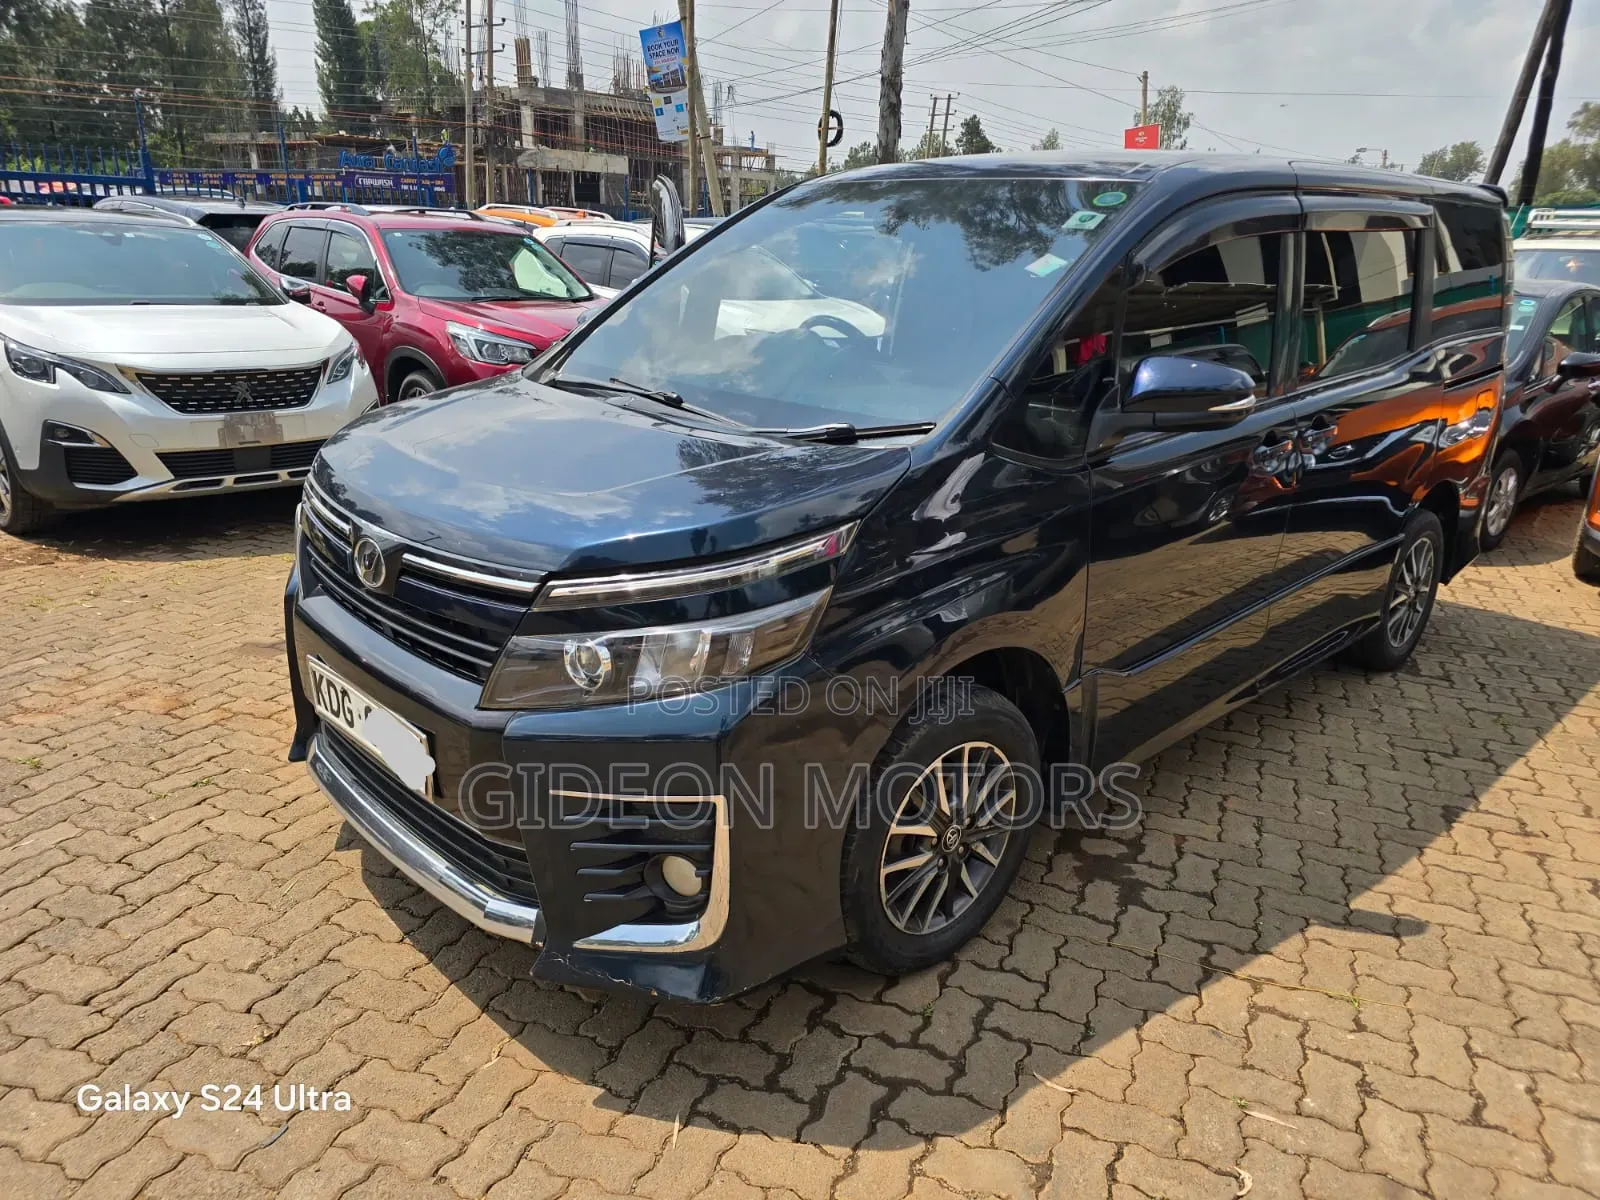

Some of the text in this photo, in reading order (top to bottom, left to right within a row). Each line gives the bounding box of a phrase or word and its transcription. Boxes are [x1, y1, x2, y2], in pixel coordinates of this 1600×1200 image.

[647, 39, 679, 52] BOOK YOUR
[667, 46, 680, 54] NOW
[312, 670, 355, 729] KDG
